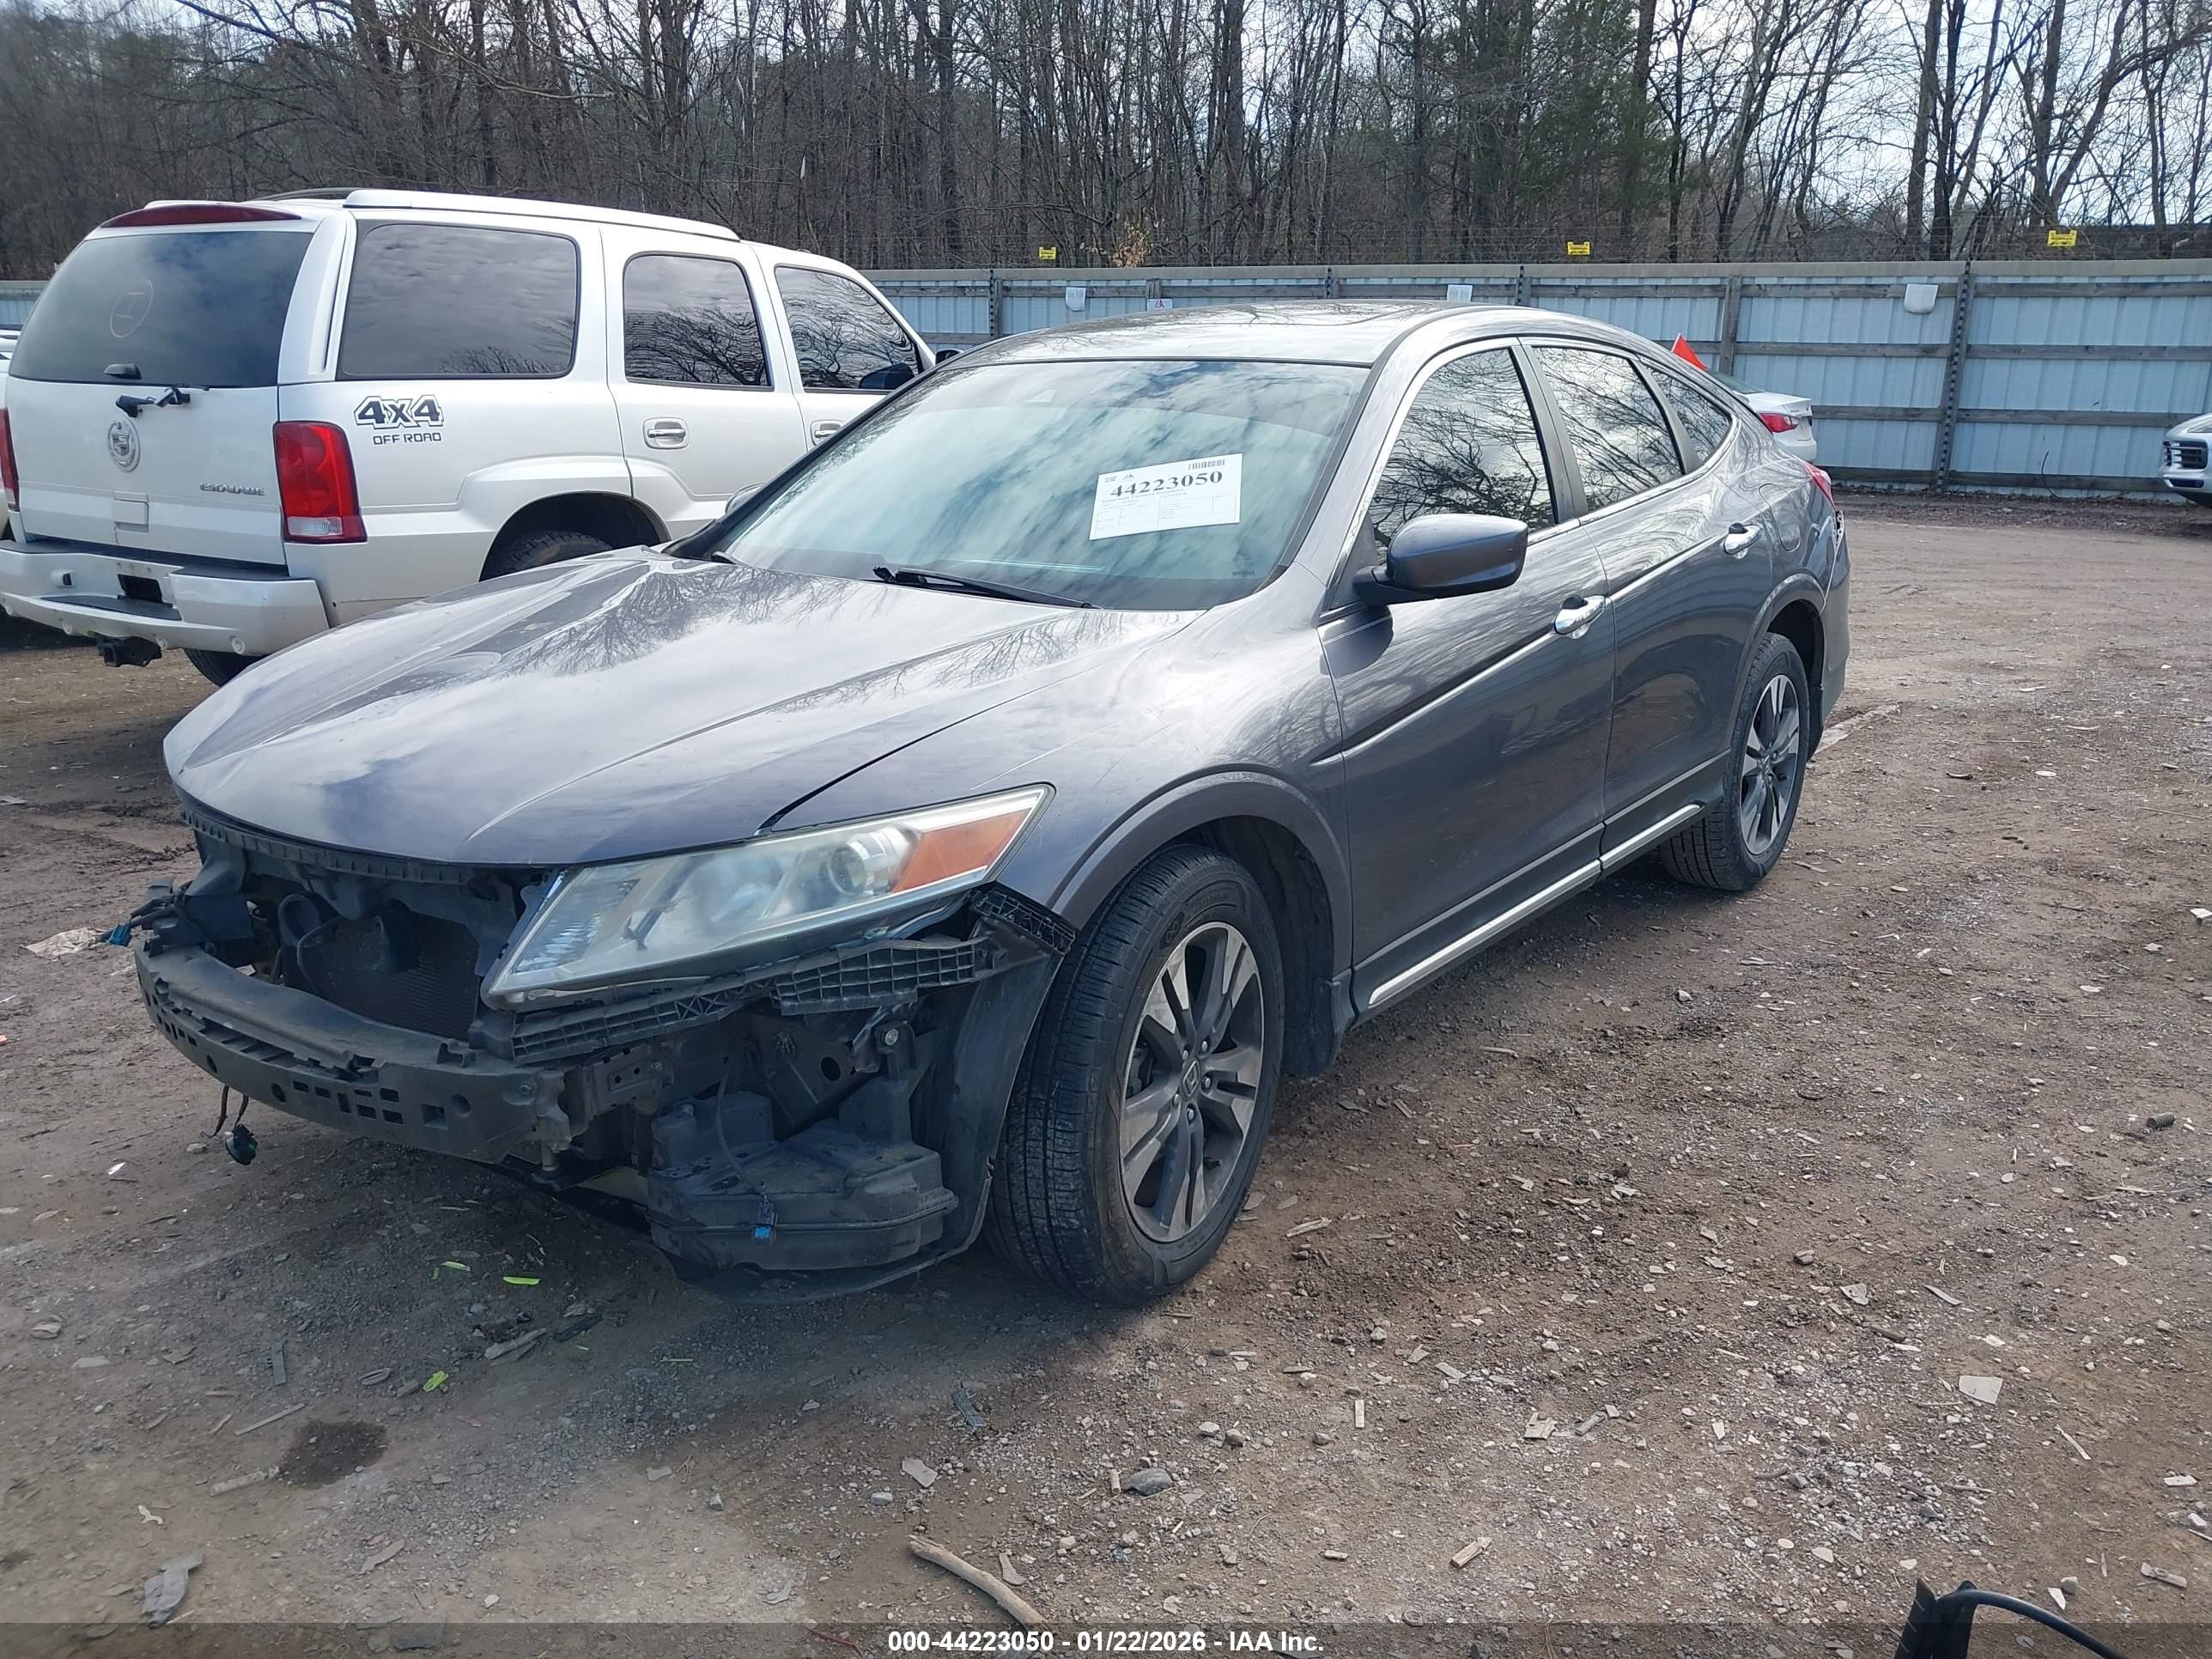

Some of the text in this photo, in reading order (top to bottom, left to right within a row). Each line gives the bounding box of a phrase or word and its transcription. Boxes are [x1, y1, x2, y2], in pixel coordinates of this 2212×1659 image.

[354, 395, 444, 428] 4x4
[373, 432, 441, 445] OFF ROAD
[1110, 471, 1223, 497] 44223050
